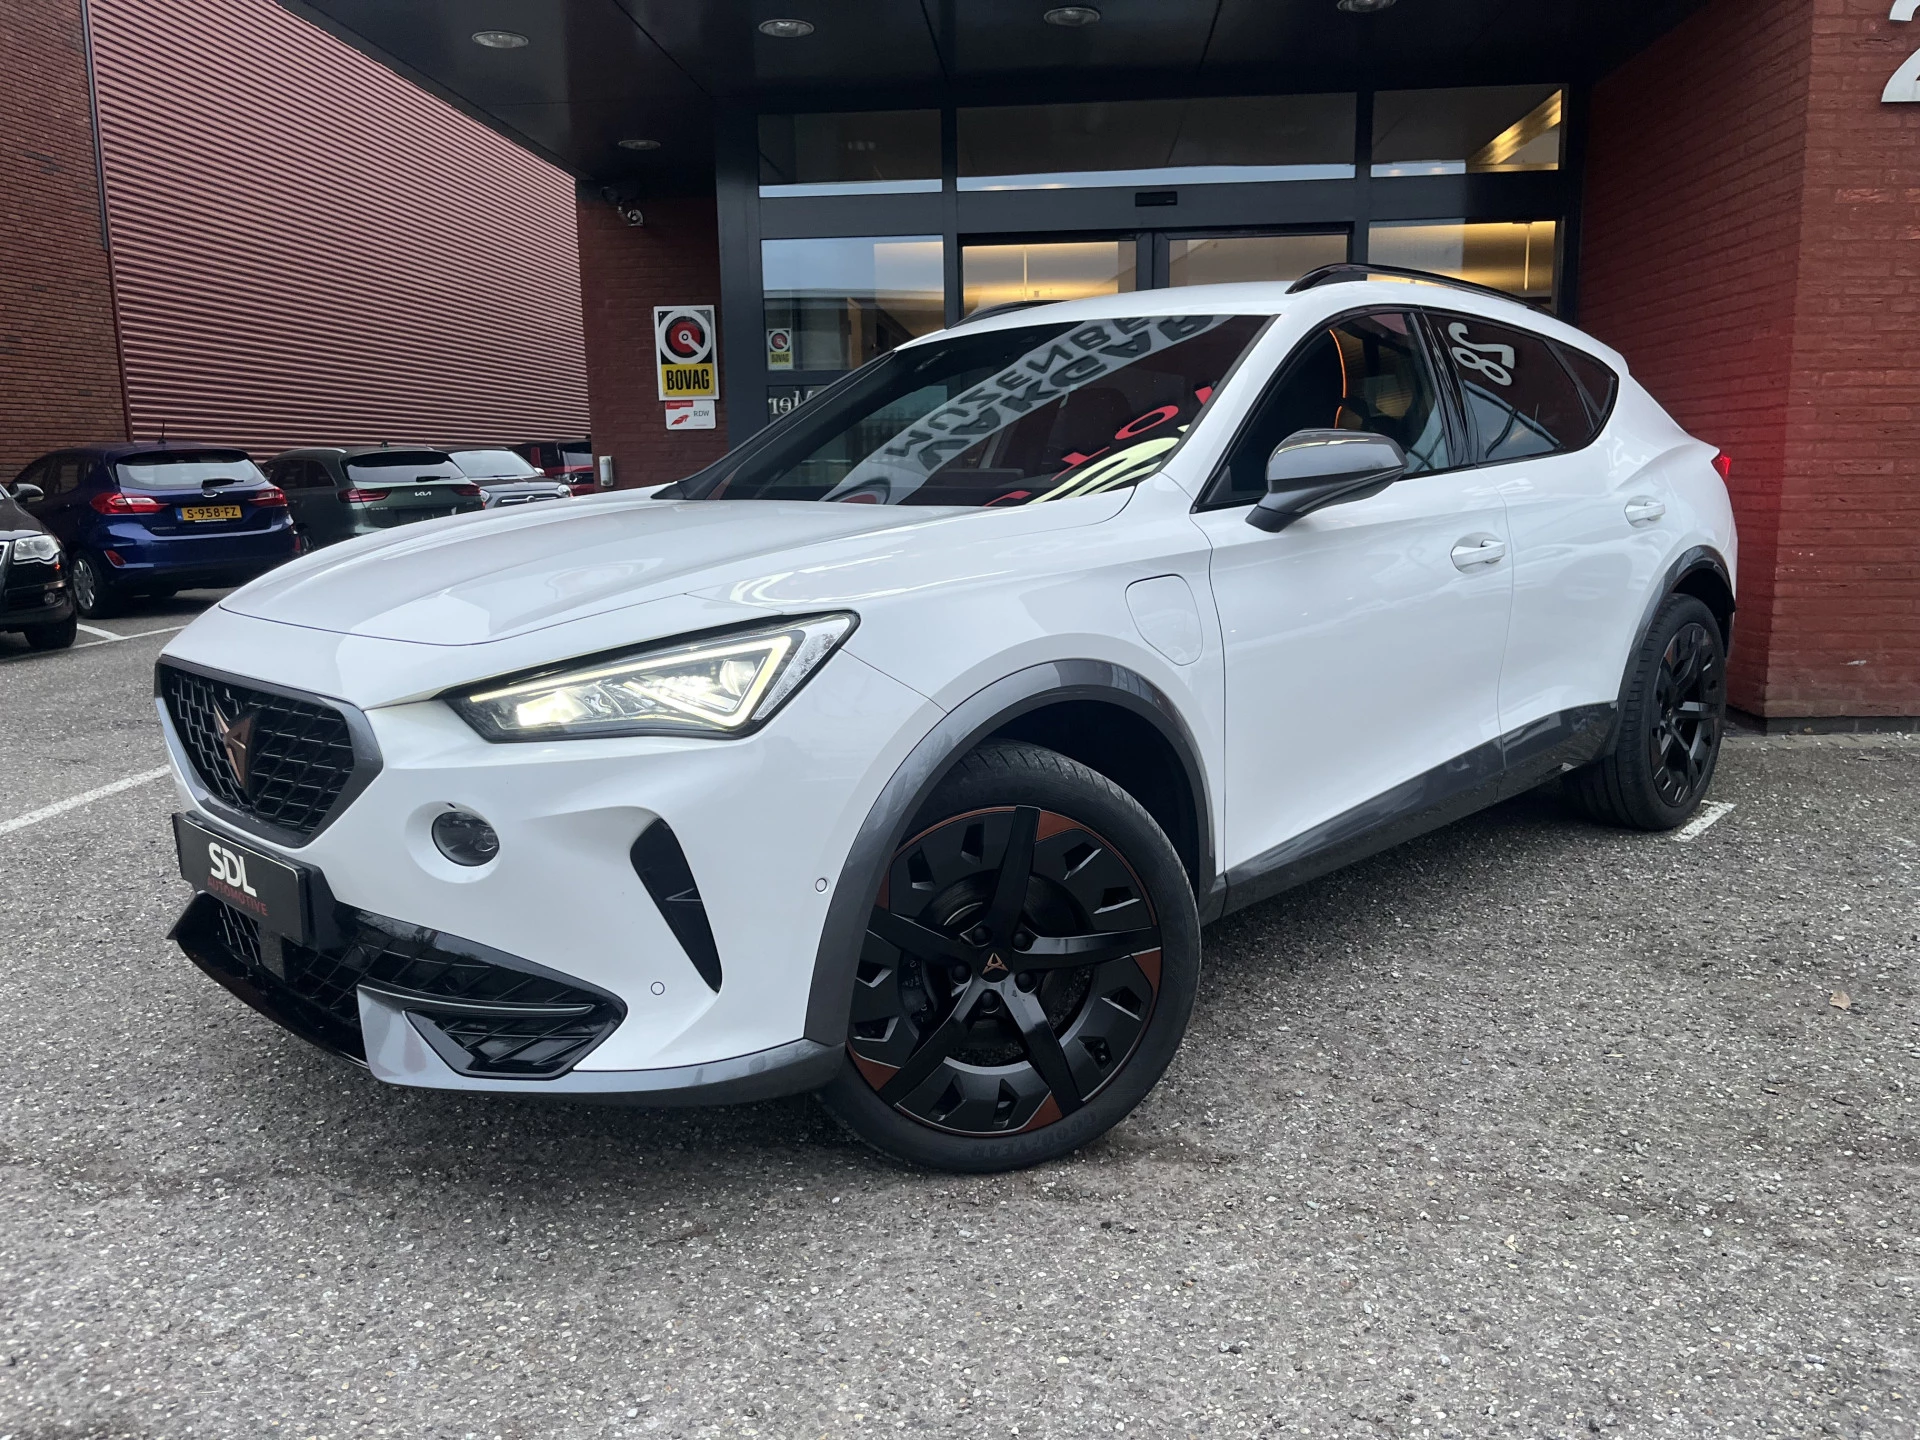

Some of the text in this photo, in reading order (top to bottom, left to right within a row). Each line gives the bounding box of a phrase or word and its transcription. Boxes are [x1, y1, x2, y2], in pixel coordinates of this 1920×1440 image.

[666, 369, 710, 390] BOVAG
[186, 506, 238, 519] S-958-FZ
[208, 842, 258, 898] SDL
[207, 875, 268, 916] AUTOMOTIVE
